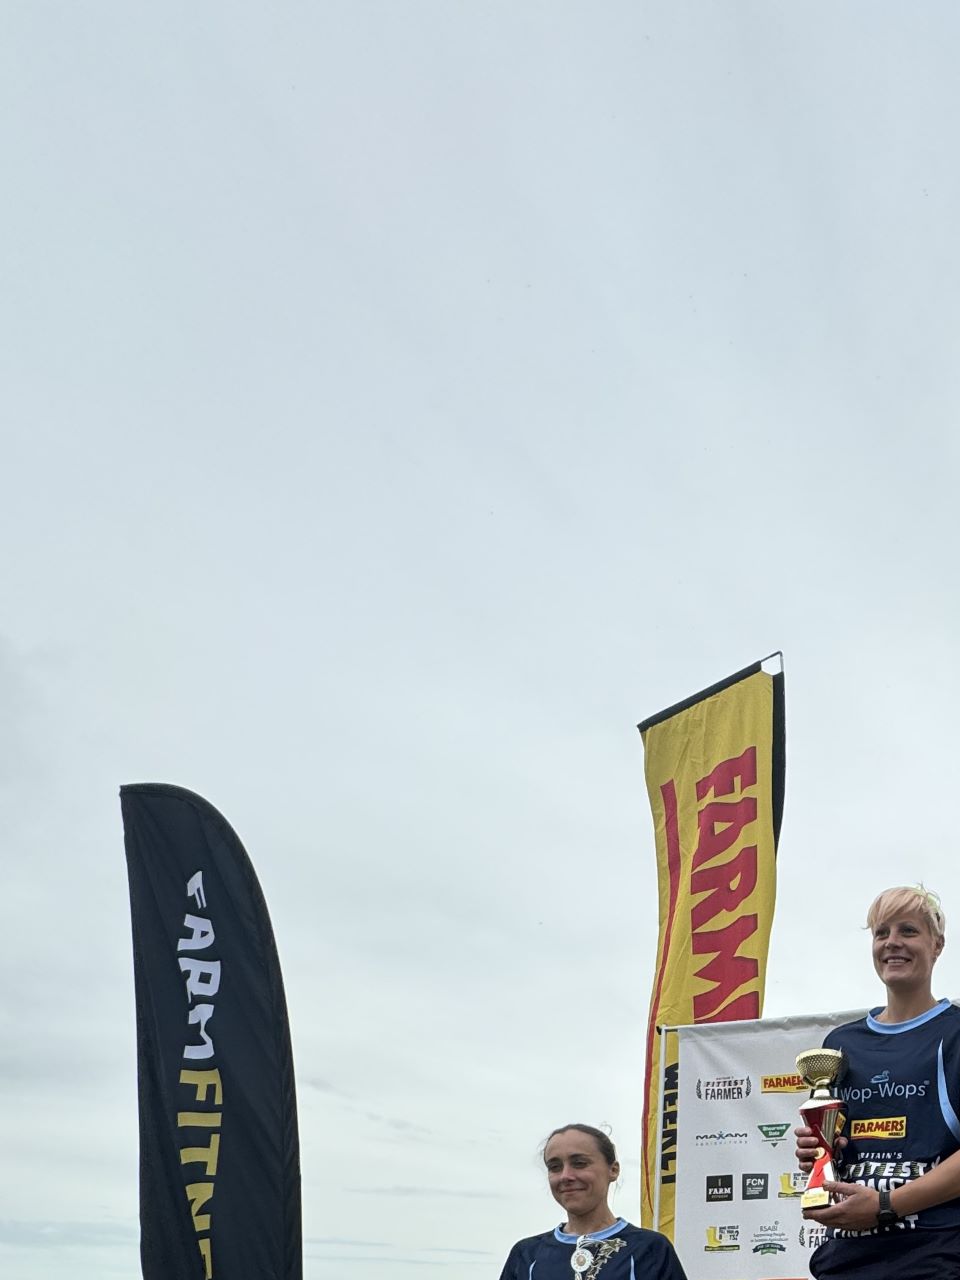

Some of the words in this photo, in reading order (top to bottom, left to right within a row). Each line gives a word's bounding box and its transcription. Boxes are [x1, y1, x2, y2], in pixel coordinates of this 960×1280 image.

[690, 746, 759, 1023] FARM
[705, 1079, 745, 1087] FITTEST
[763, 1075, 804, 1089] FARMER
[705, 1087, 743, 1101] FARMER
[840, 1082, 926, 1102] Wop-Wops
[853, 1120, 905, 1134] FARMERS
[696, 1131, 748, 1140] MAXAM
